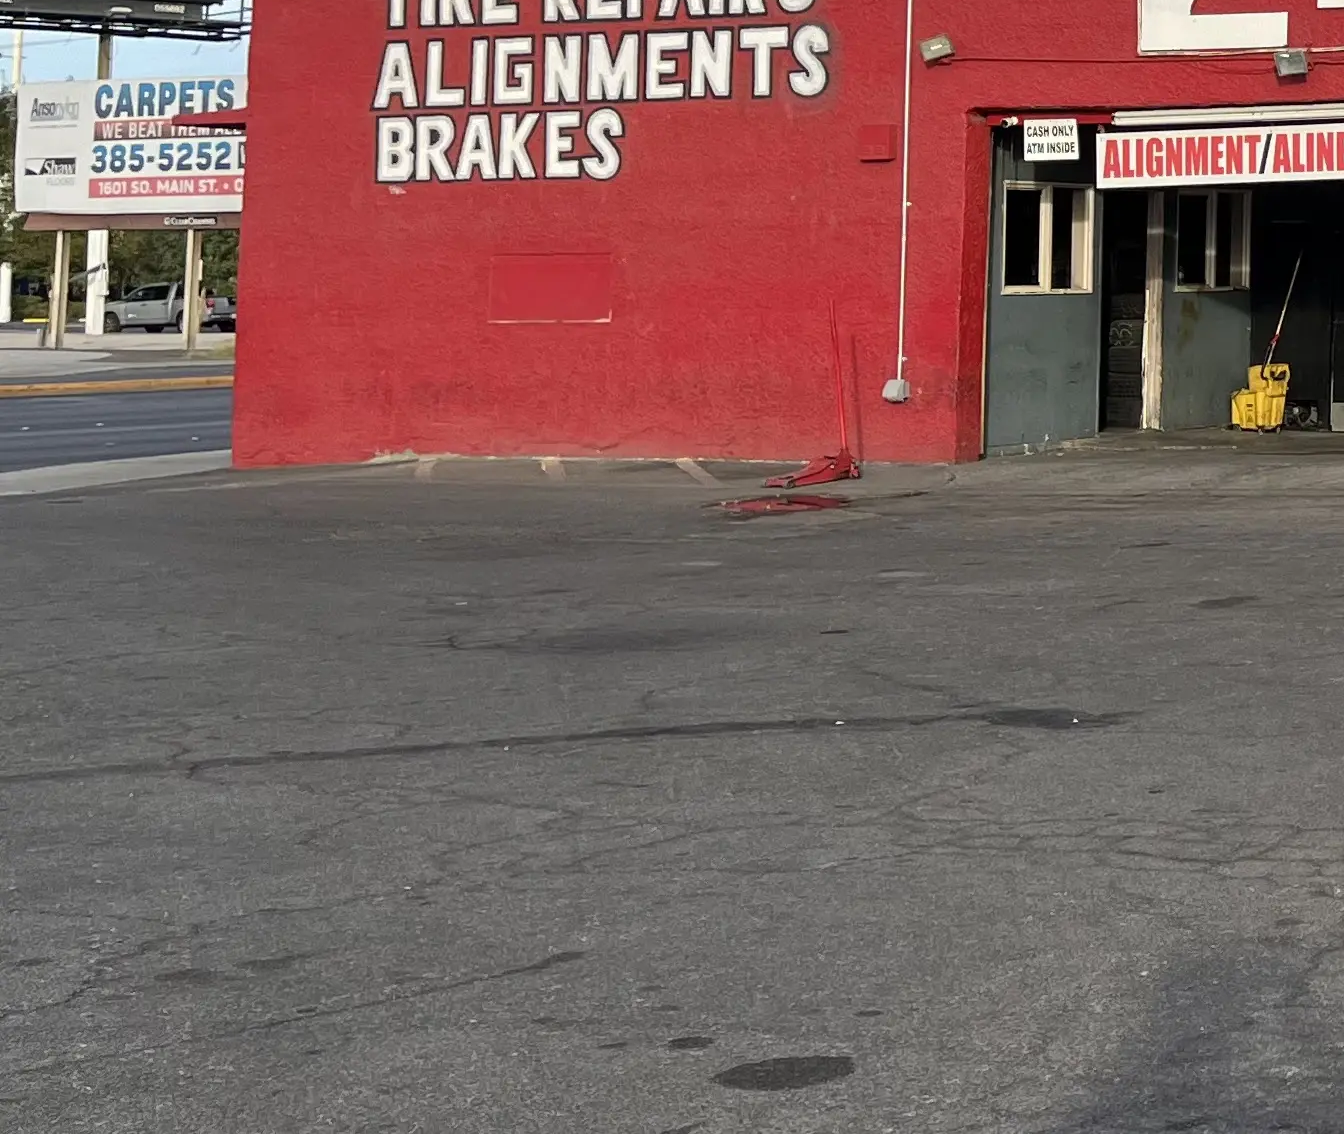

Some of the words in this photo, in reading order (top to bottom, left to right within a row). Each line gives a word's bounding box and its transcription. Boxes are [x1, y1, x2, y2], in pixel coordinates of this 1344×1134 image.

[373, 23, 831, 109] ALIGNMENTS
[94, 79, 235, 118] CARPETS
[102, 123, 123, 139] WE
[129, 121, 164, 138] BEAT
[1027, 126, 1050, 137] CASH
[1052, 125, 1074, 136] ONLY
[375, 108, 624, 183] BRAKES
[1027, 143, 1045, 154] ATM
[1047, 142, 1076, 153] INSIDE
[91, 141, 232, 173] 385-5252
[44, 158, 75, 176] Shaw
[98, 182, 127, 195] 1601
[130, 181, 152, 194] SO.
[156, 179, 194, 193] MAIN
[198, 177, 219, 192] ST.
